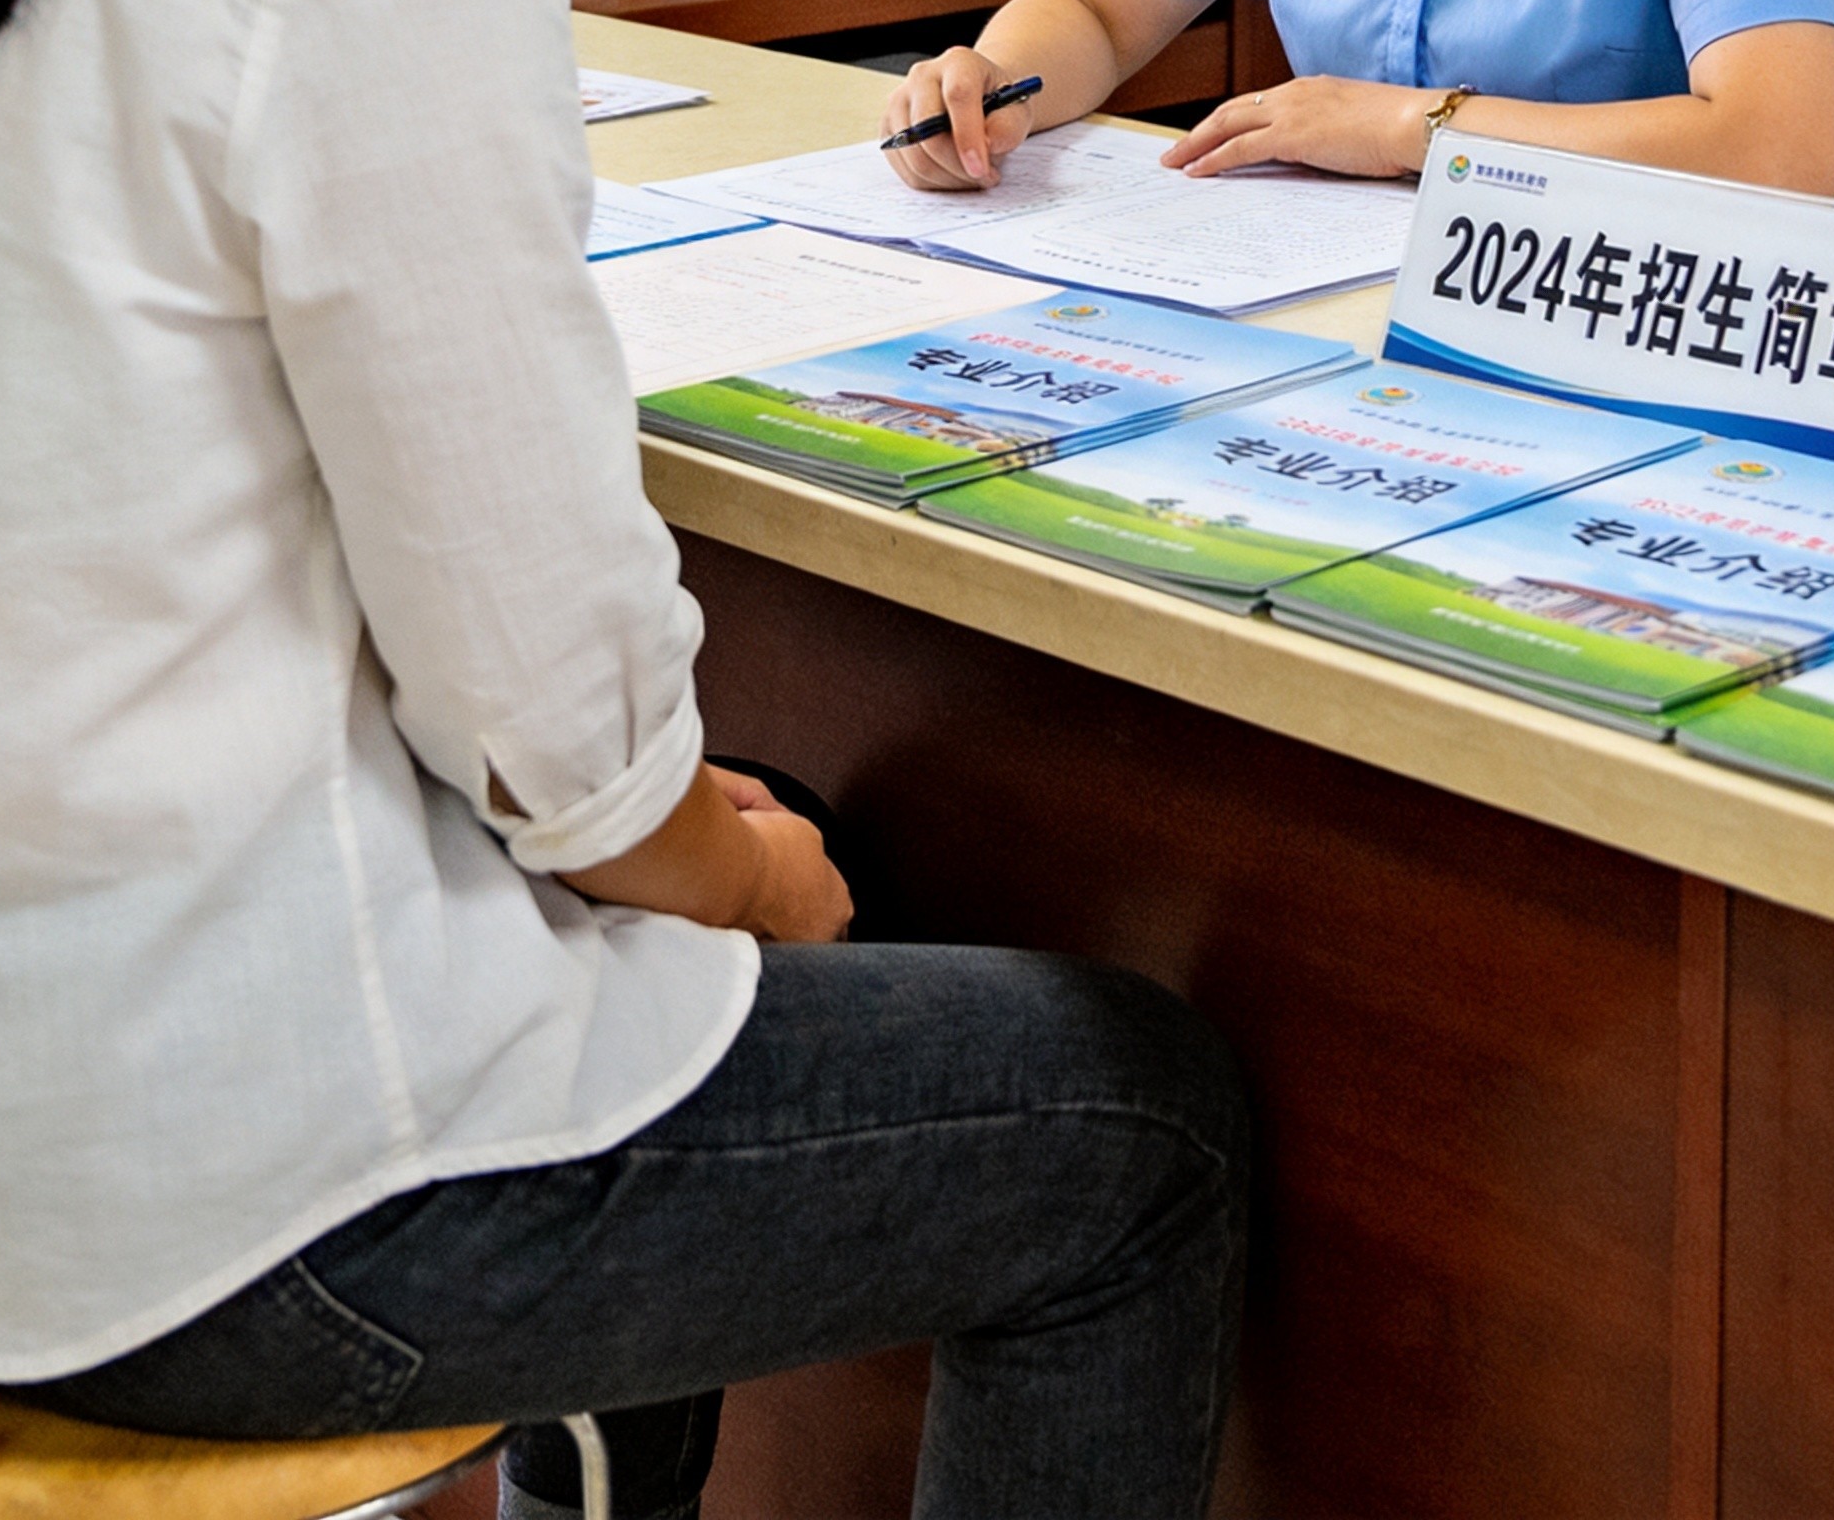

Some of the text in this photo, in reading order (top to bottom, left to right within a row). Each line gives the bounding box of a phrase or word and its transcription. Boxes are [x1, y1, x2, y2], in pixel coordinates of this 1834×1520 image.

[907, 347, 1121, 405] 专业介绍
[1214, 435, 1459, 505] 专业介绍
